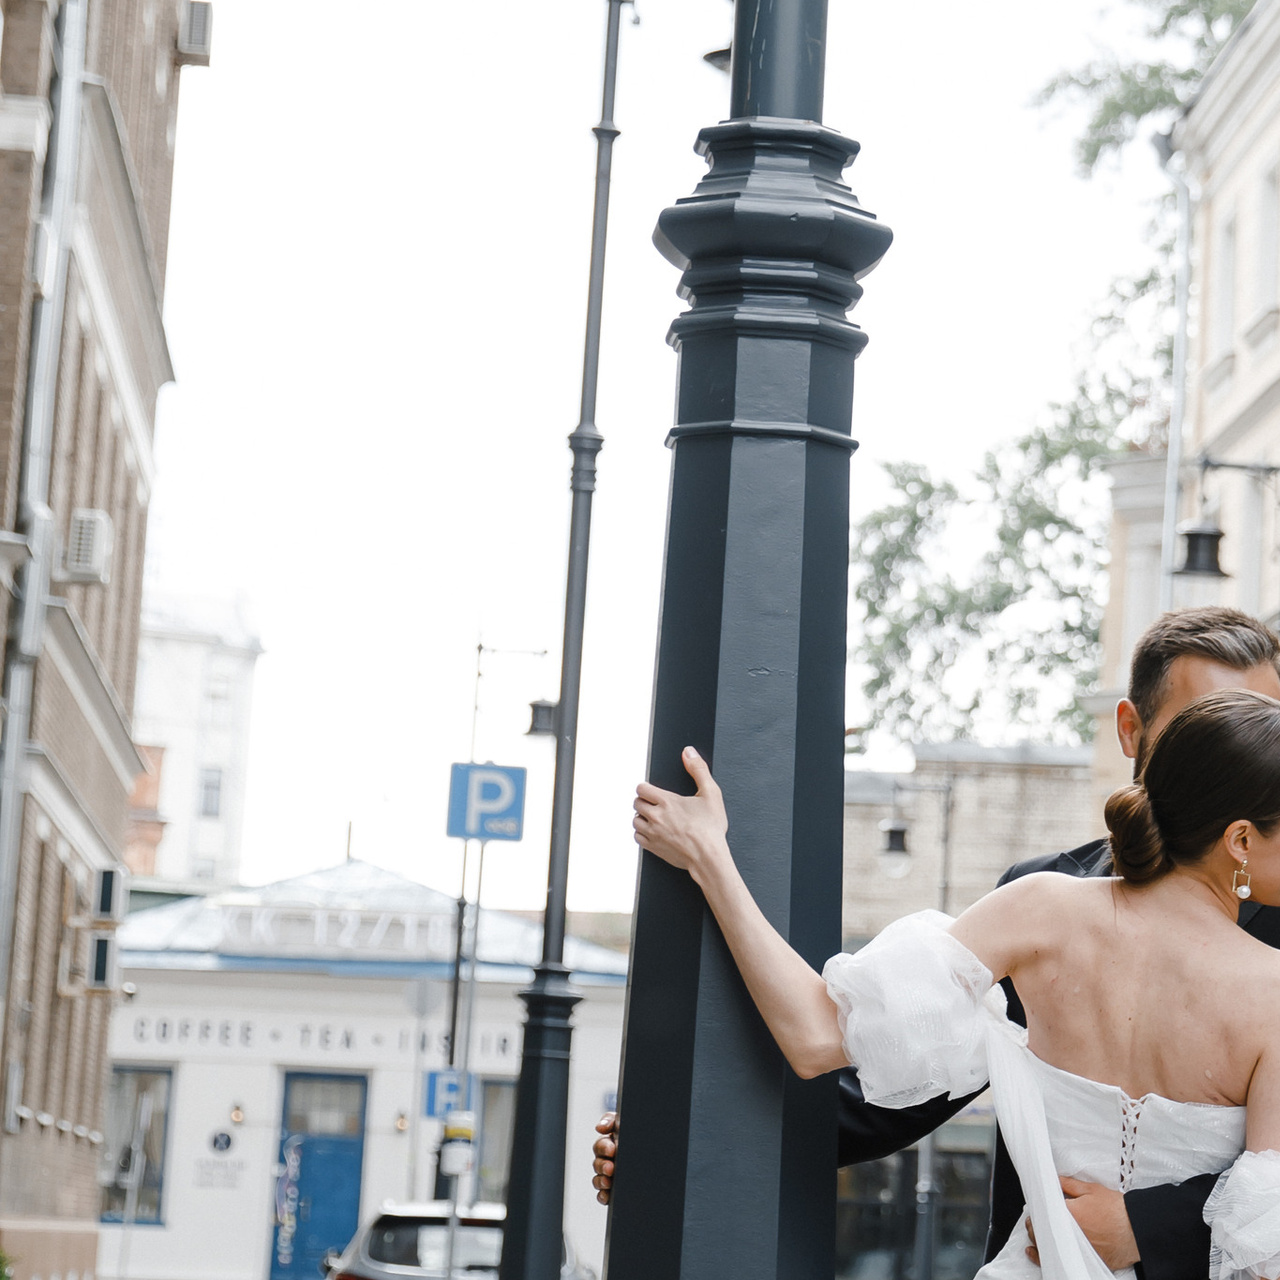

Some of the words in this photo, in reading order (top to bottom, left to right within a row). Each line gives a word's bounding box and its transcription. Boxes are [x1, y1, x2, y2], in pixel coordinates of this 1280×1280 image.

[465, 769, 516, 834] P
[133, 1018, 253, 1047] COFFEE
[299, 1023, 356, 1051] TEA
